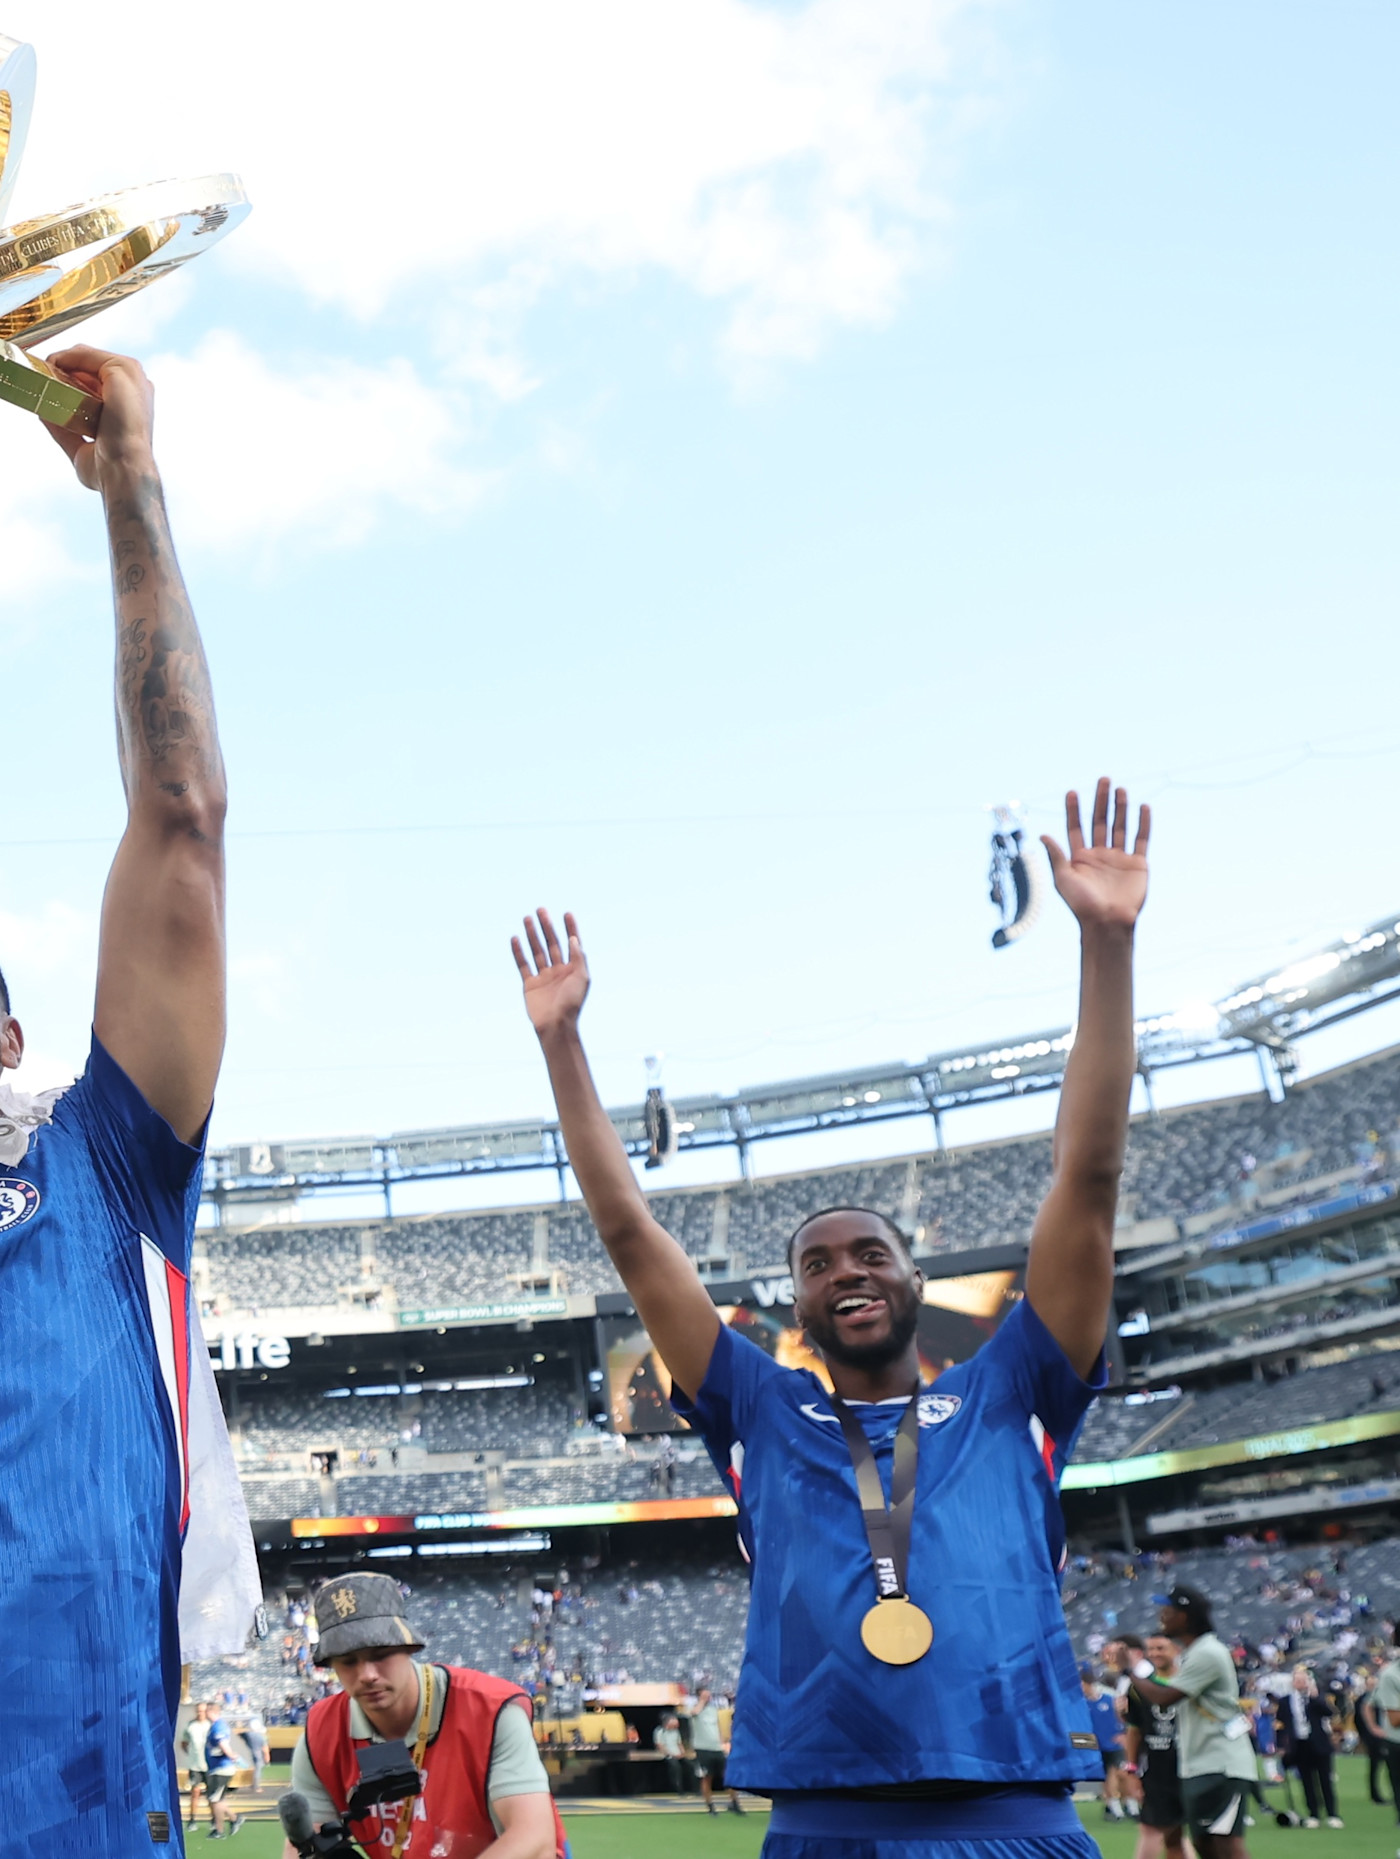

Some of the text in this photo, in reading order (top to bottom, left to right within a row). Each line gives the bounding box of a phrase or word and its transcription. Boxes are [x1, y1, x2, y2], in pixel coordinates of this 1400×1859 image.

[0, 251, 18, 266] DE
[20, 234, 60, 259] CLUBES
[61, 223, 85, 243] FIFA
[21, 1203, 34, 1220] CLUB
[424, 1308, 458, 1322] SUPER
[459, 1305, 493, 1320] BOWL
[876, 1556, 900, 1596] FIFA
